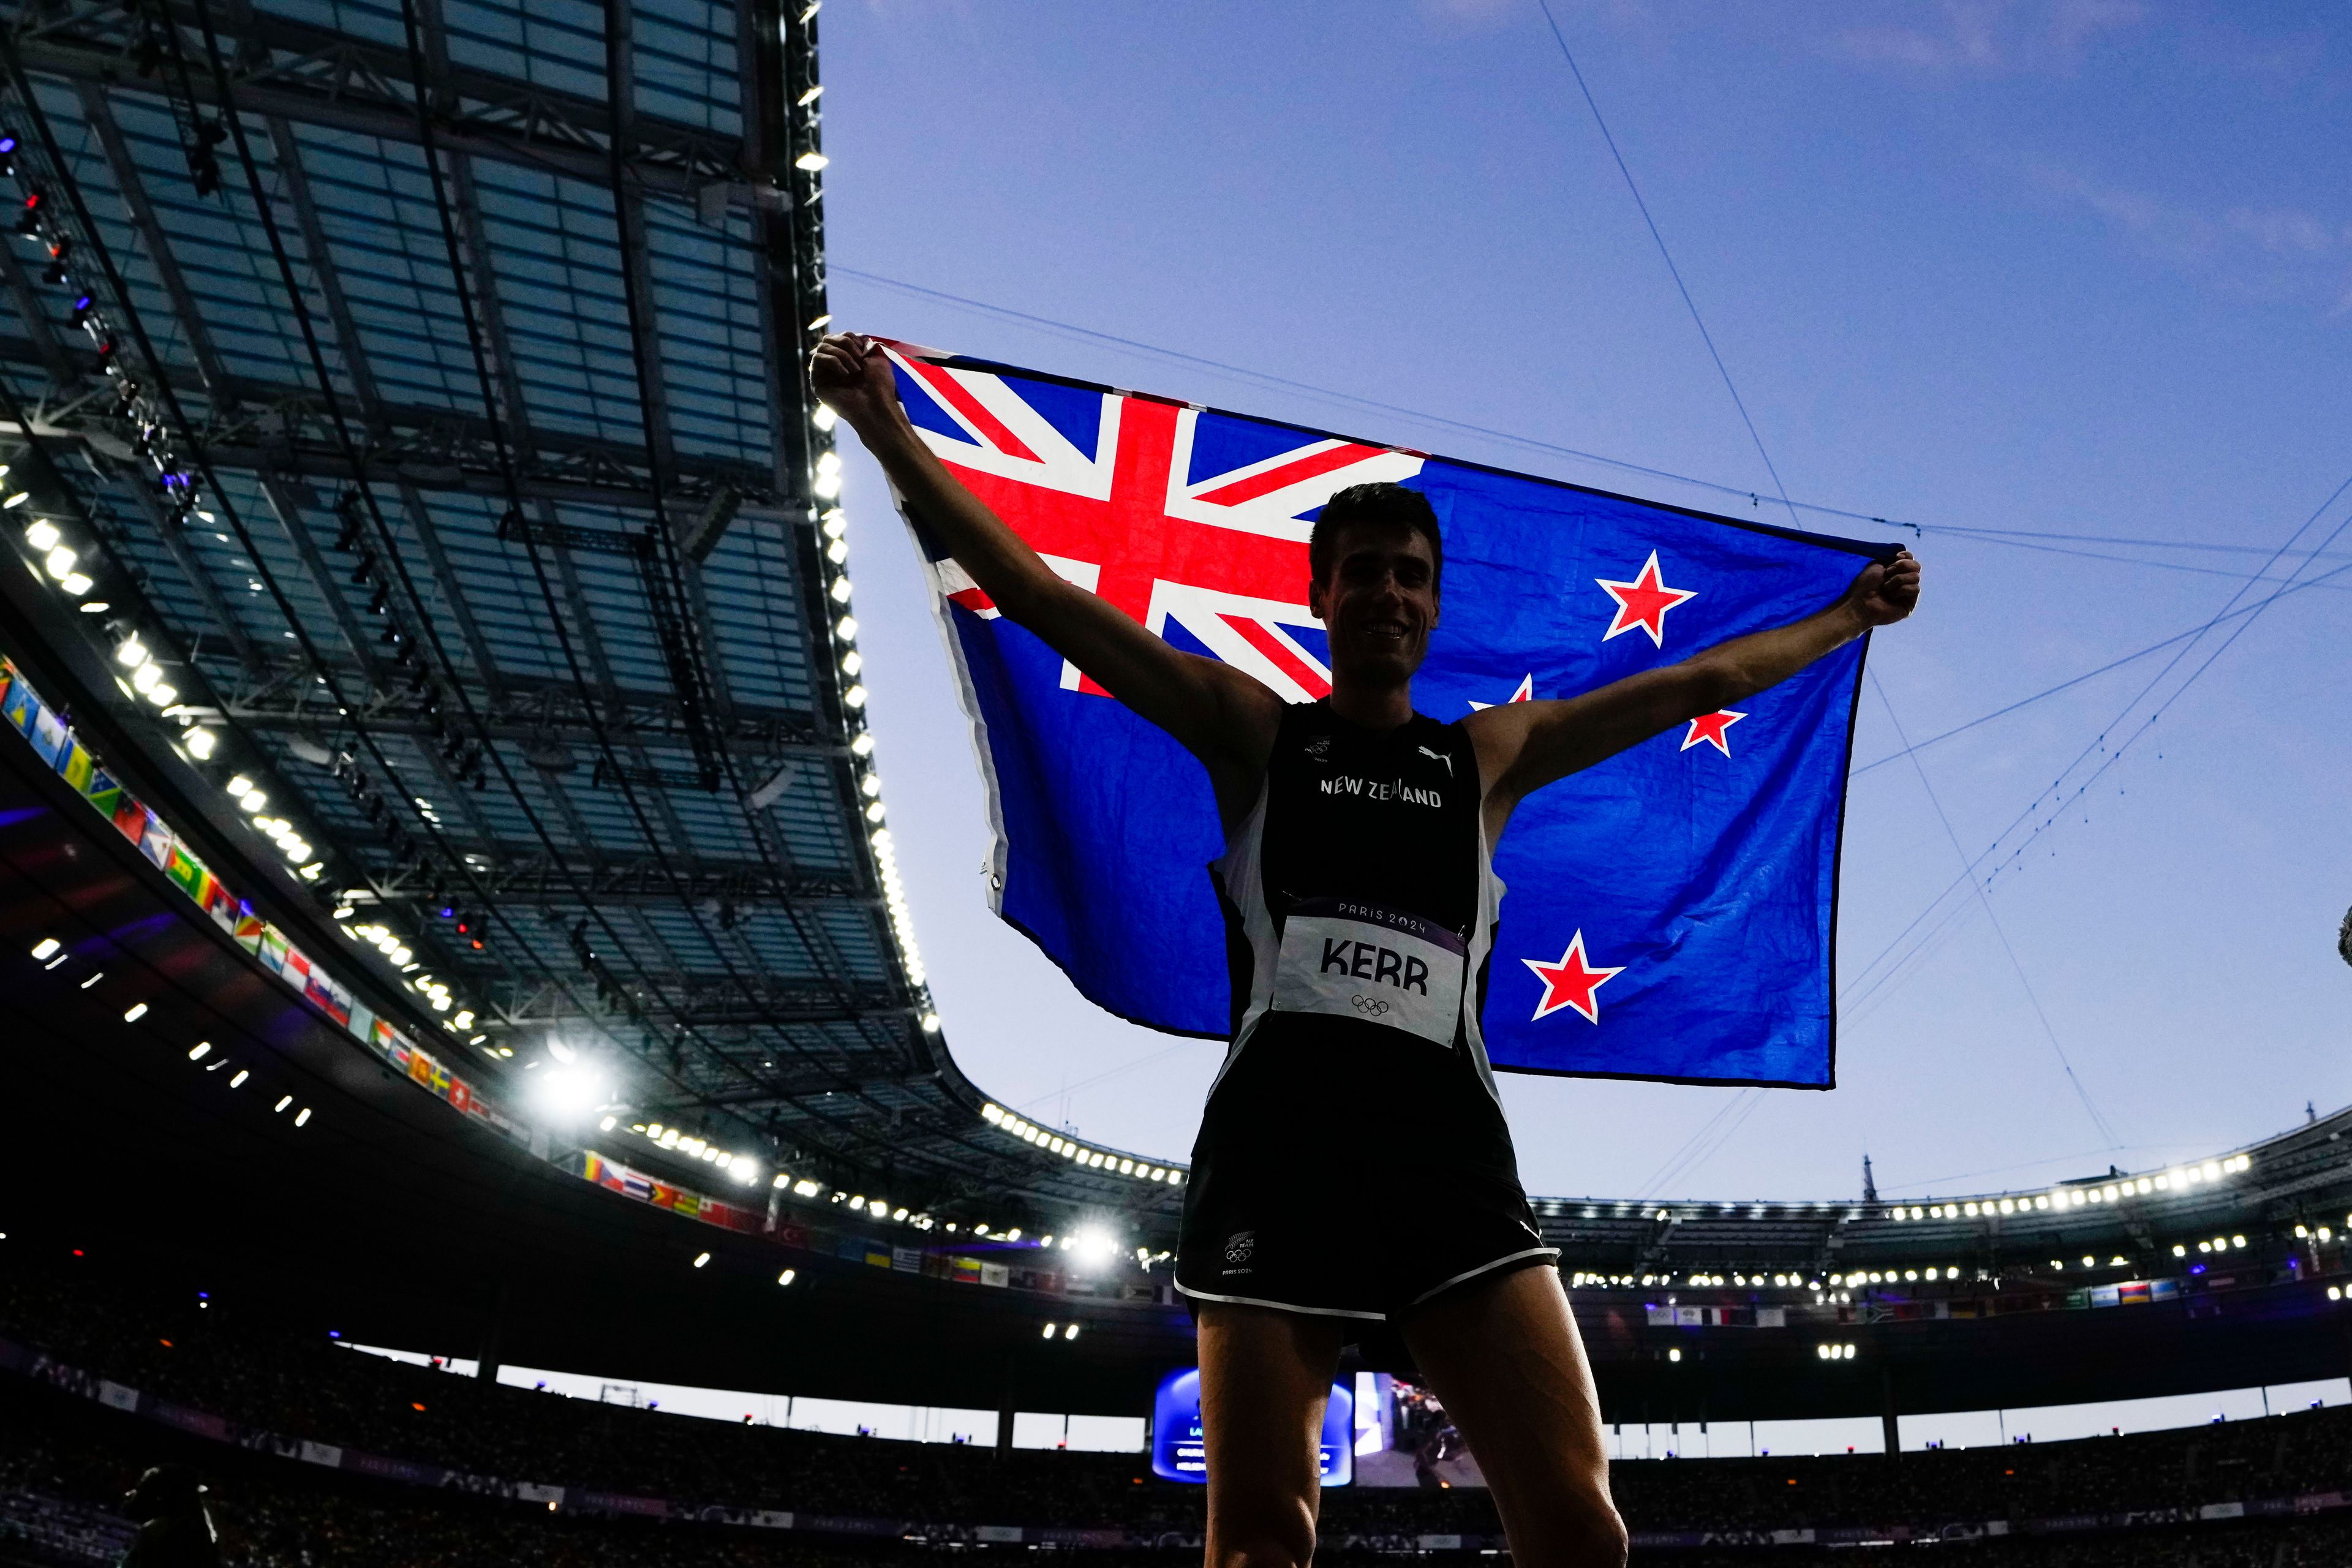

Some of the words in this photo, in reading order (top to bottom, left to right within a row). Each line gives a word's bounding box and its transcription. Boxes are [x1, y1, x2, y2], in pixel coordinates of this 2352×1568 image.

[1321, 775, 1363, 795] NEW
[1368, 778, 1441, 808] ZEALAND
[1338, 903, 1383, 919] PARIS
[1389, 913, 1426, 933] 2024
[1321, 938, 1429, 997] KERR
